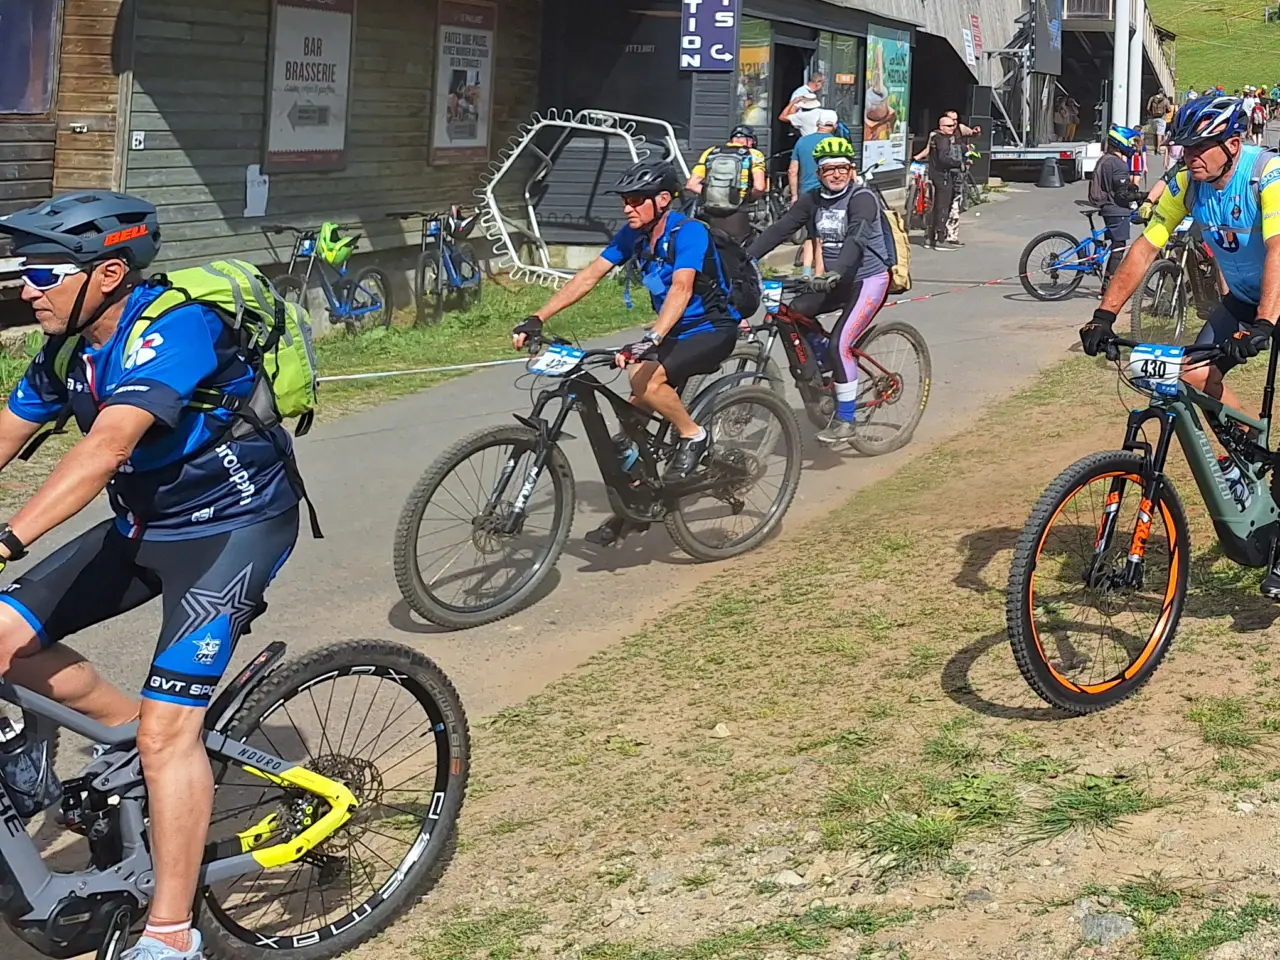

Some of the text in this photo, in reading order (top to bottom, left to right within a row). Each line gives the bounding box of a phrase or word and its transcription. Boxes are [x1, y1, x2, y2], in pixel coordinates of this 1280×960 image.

[304, 37, 322, 57] BAR
[285, 61, 337, 83] BRASSERIE
[104, 224, 149, 247] BELL
[1141, 360, 1166, 378] 430
[1130, 520, 1152, 557] FOX
[150, 675, 186, 692] GVT
[416, 674, 460, 758] SCHWALBE
[238, 747, 282, 770] NDURO
